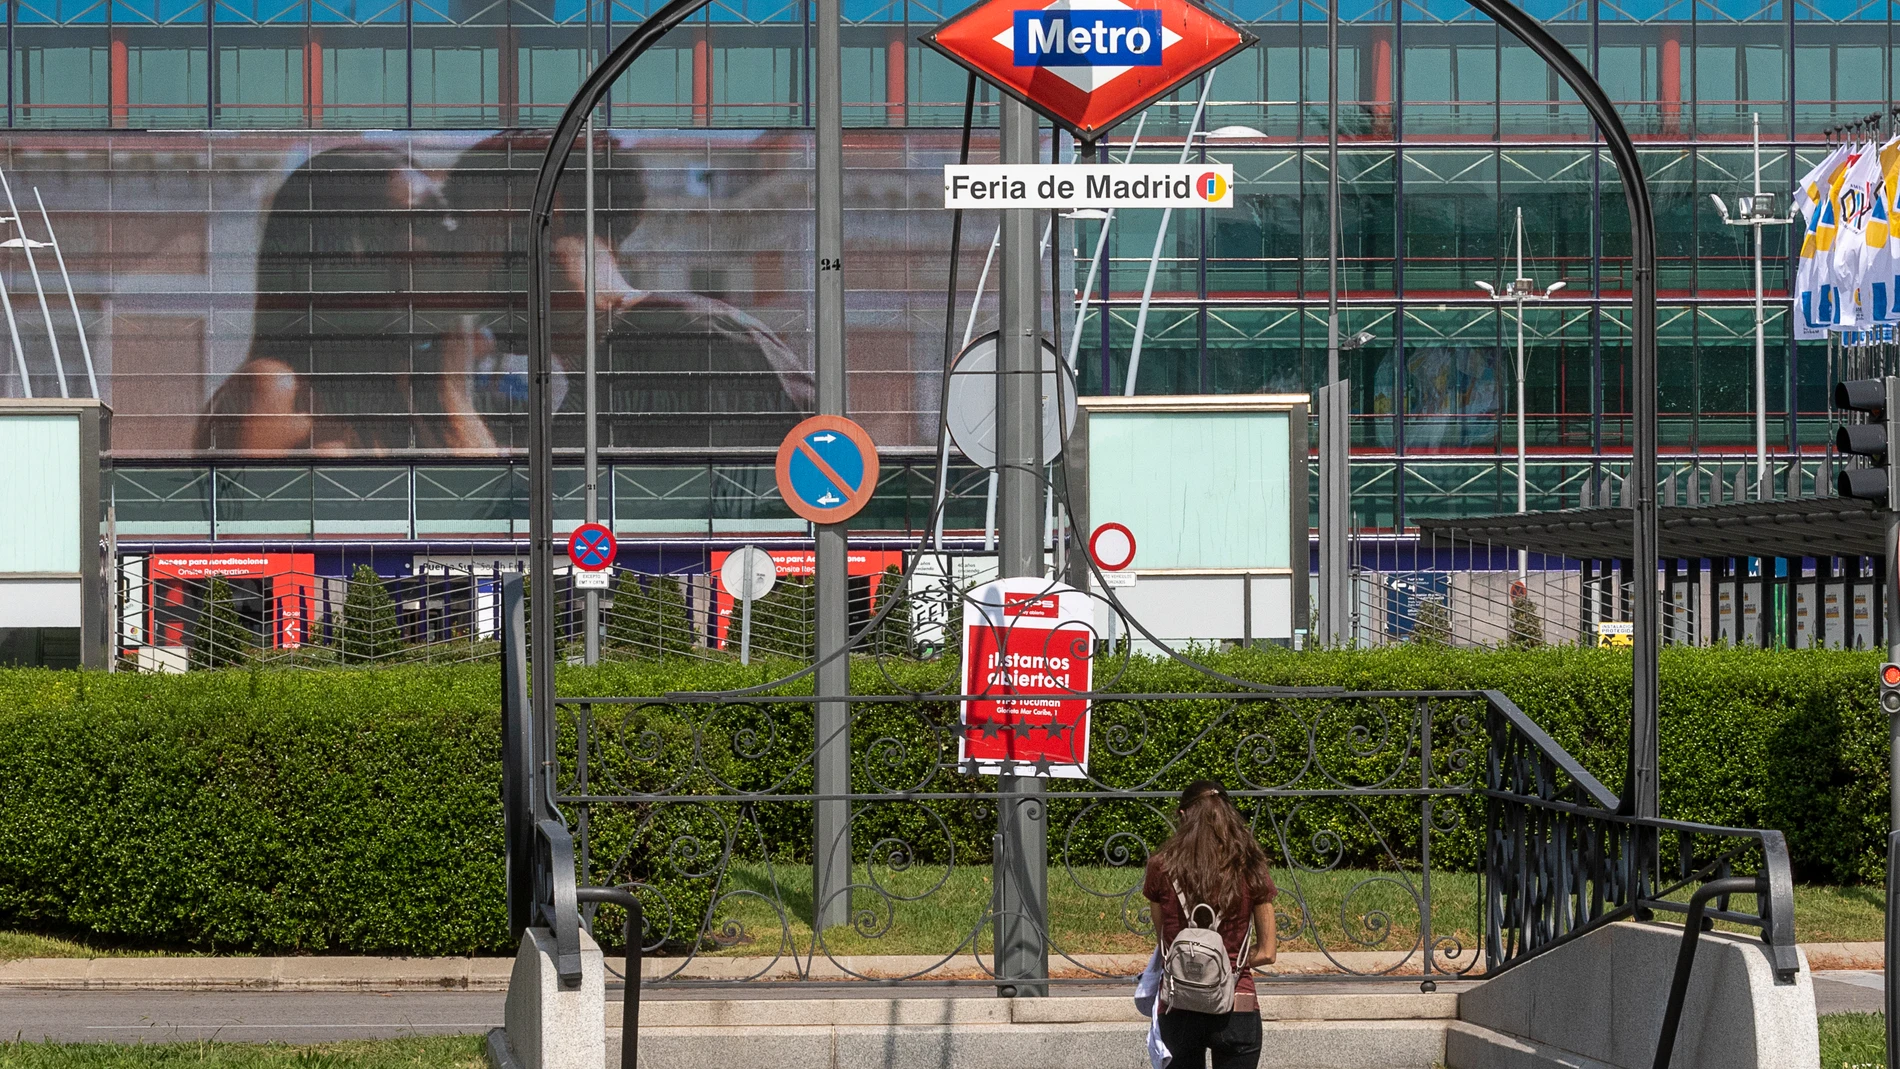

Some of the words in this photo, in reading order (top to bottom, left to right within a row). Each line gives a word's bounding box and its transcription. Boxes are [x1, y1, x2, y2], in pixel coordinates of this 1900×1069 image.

[1028, 18, 1152, 55] Metro
[952, 174, 1027, 200] Feria
[1037, 174, 1075, 200] de
[1086, 174, 1192, 200] Madrid
[821, 258, 841, 271] 24
[188, 559, 208, 567] para
[209, 557, 269, 566] Acreditaciones
[178, 568, 203, 576] Onsite
[775, 565, 801, 573] Onsite
[987, 669, 1070, 689] abiertos!
[996, 707, 1019, 715] Glorieta
[1020, 707, 1032, 715] Mar
[1033, 709, 1053, 717] Caribe,
